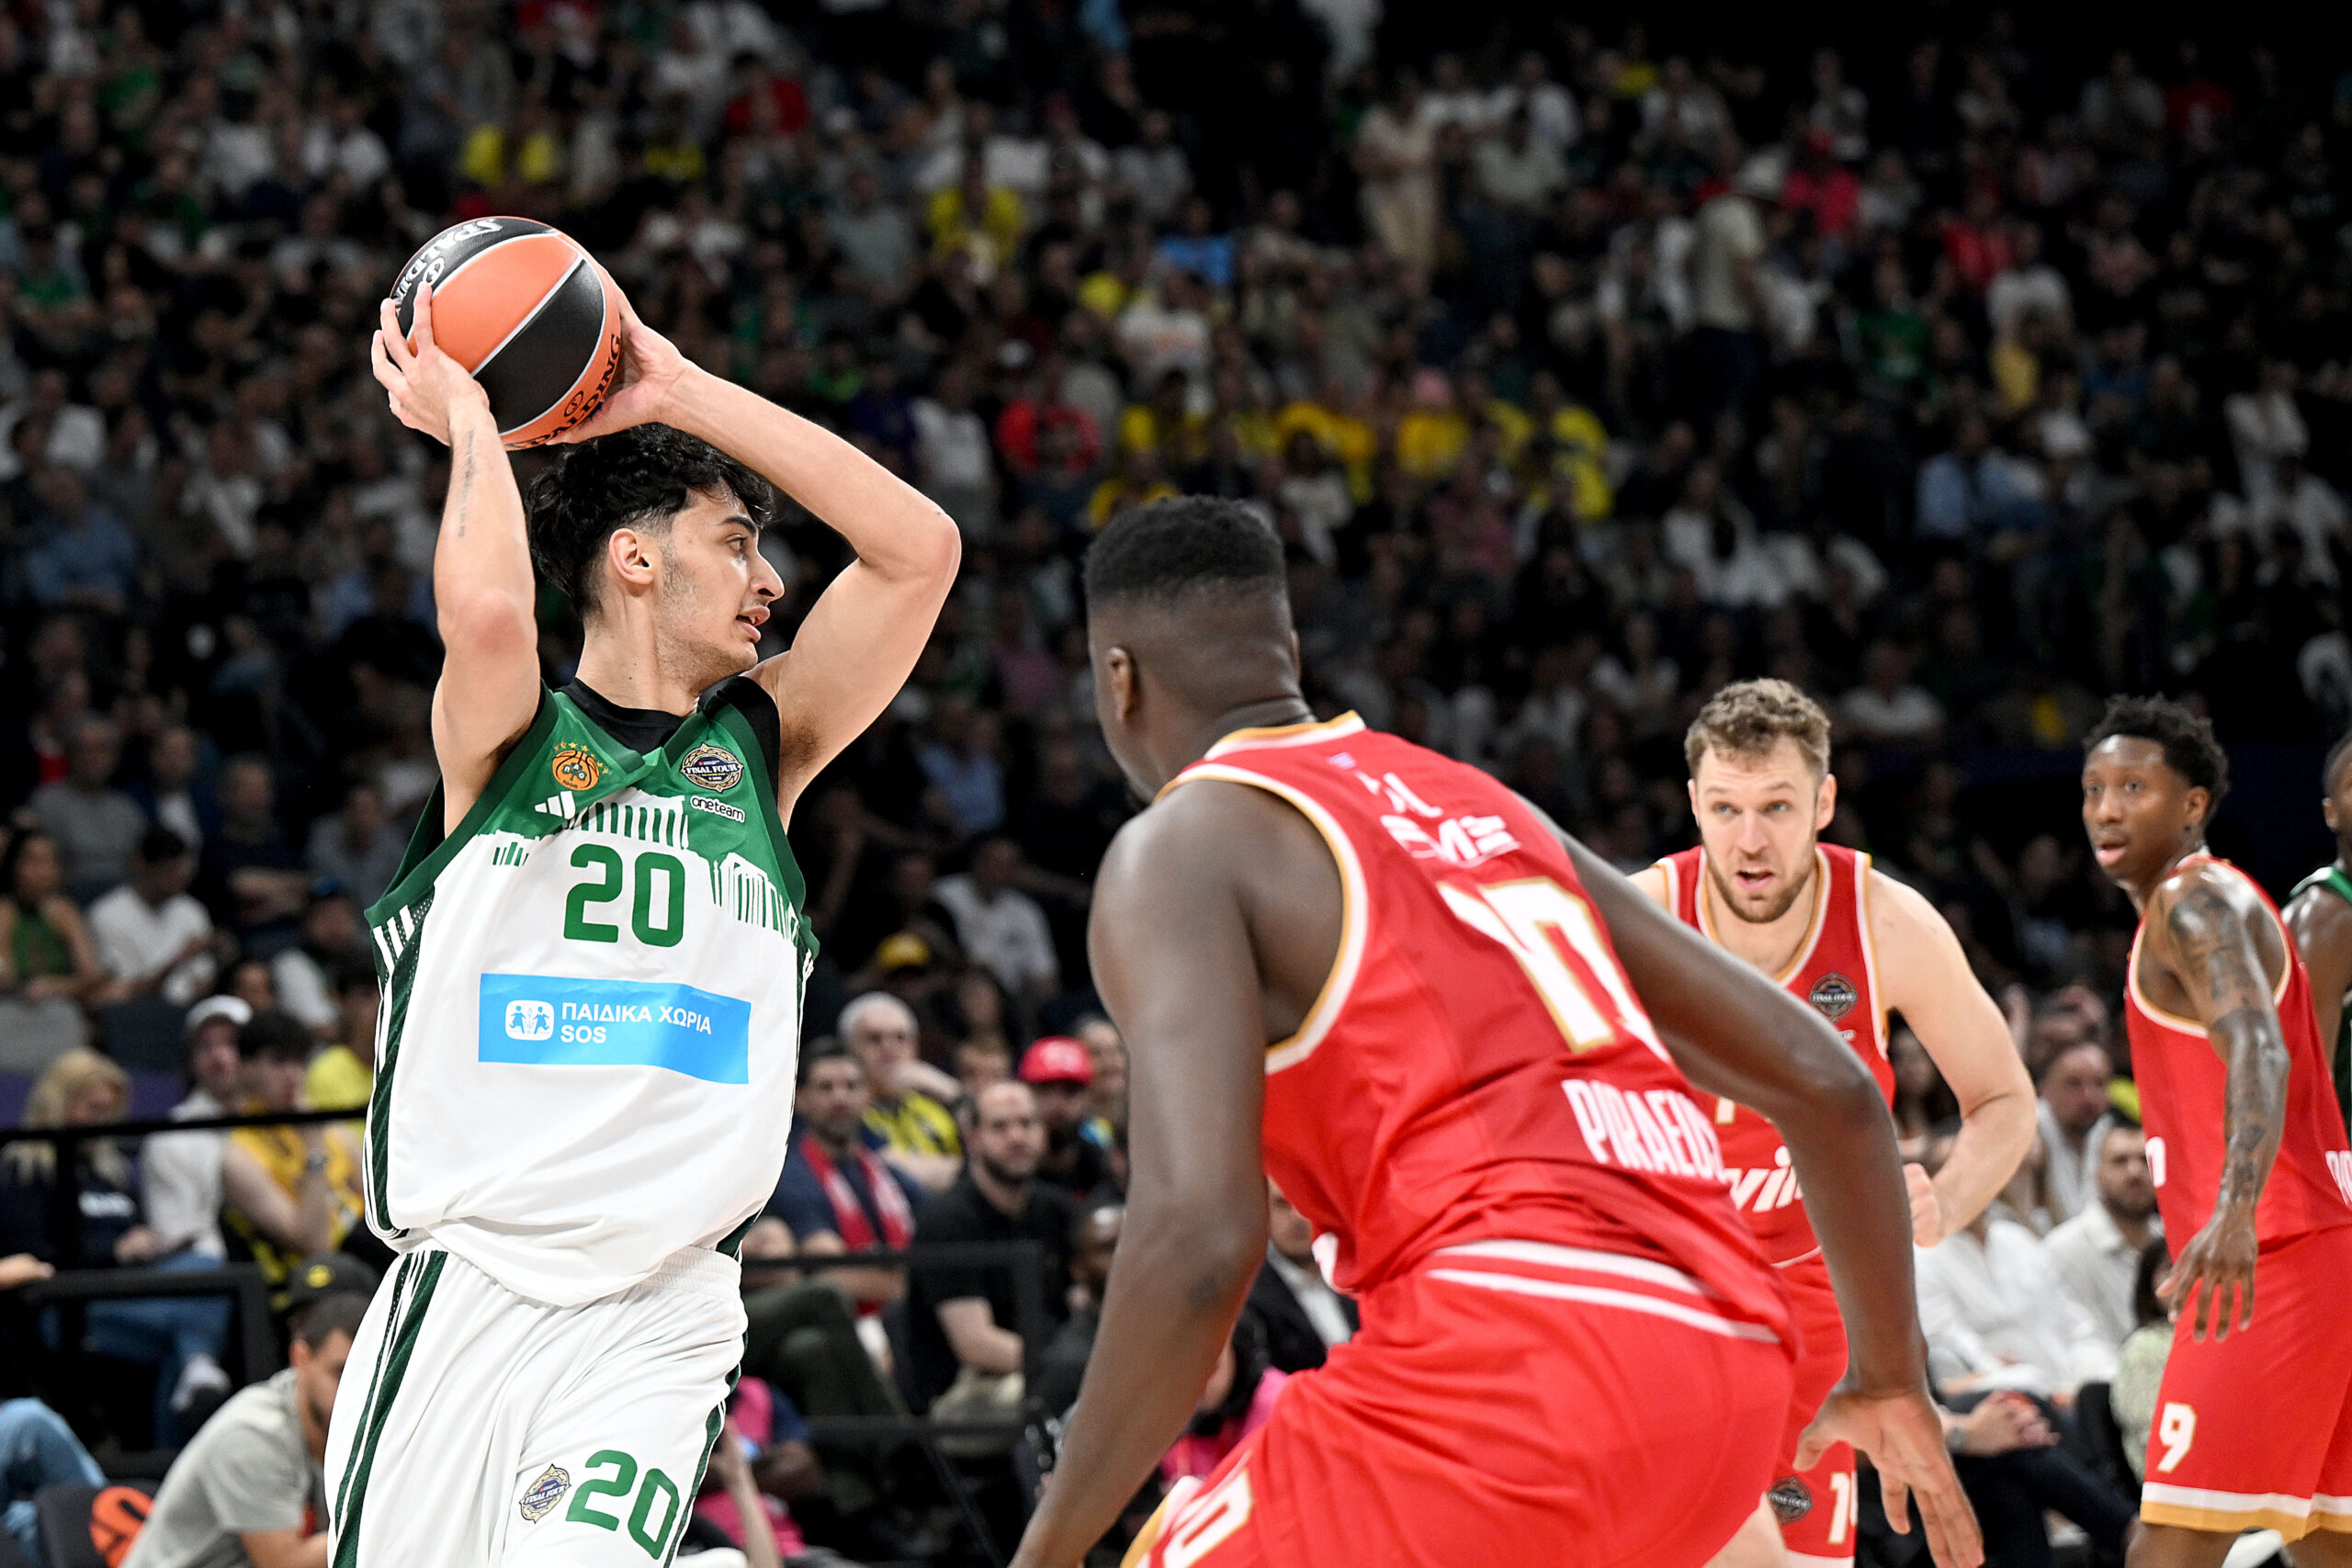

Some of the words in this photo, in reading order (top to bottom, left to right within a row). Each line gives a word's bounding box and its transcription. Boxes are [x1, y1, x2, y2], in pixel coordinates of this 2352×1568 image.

[685, 766, 713, 774] FINAL
[712, 763, 738, 773] FOUR
[691, 796, 744, 821] oneteam
[563, 843, 685, 948] 20
[560, 1024, 606, 1043] SOS
[561, 1002, 652, 1022] ΠΑΙΔΙΚΑ
[658, 1006, 712, 1035] ΧΩΡΙΑ
[2157, 1402, 2197, 1473] 9
[565, 1449, 680, 1560] 20
[1828, 1471, 1857, 1544] 1
